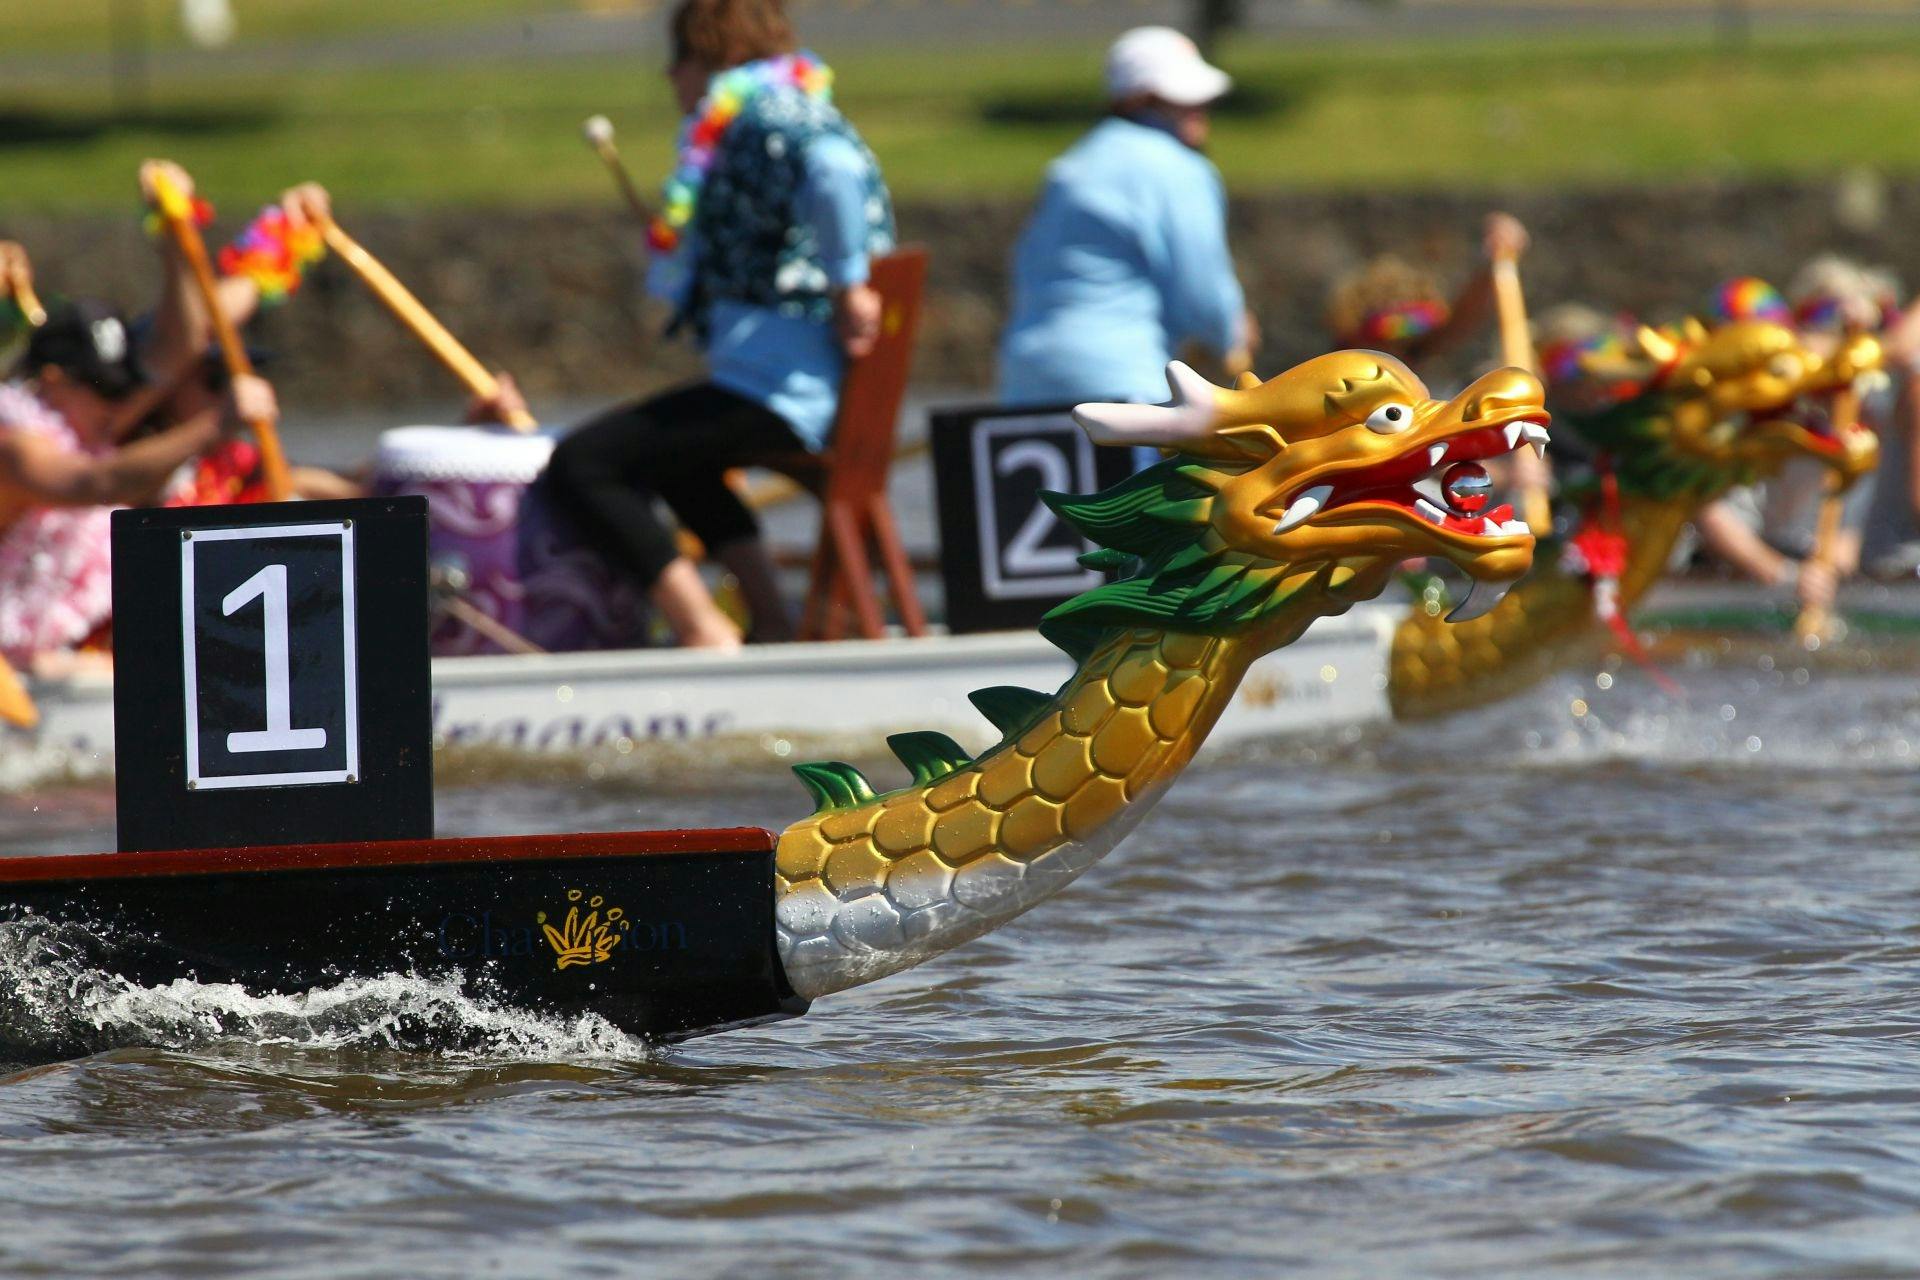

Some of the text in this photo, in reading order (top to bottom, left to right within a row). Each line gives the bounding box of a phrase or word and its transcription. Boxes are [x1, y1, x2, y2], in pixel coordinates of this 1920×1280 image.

[999, 439, 1082, 574] 2
[222, 564, 326, 753] 1
[438, 910, 690, 957] Chaion
